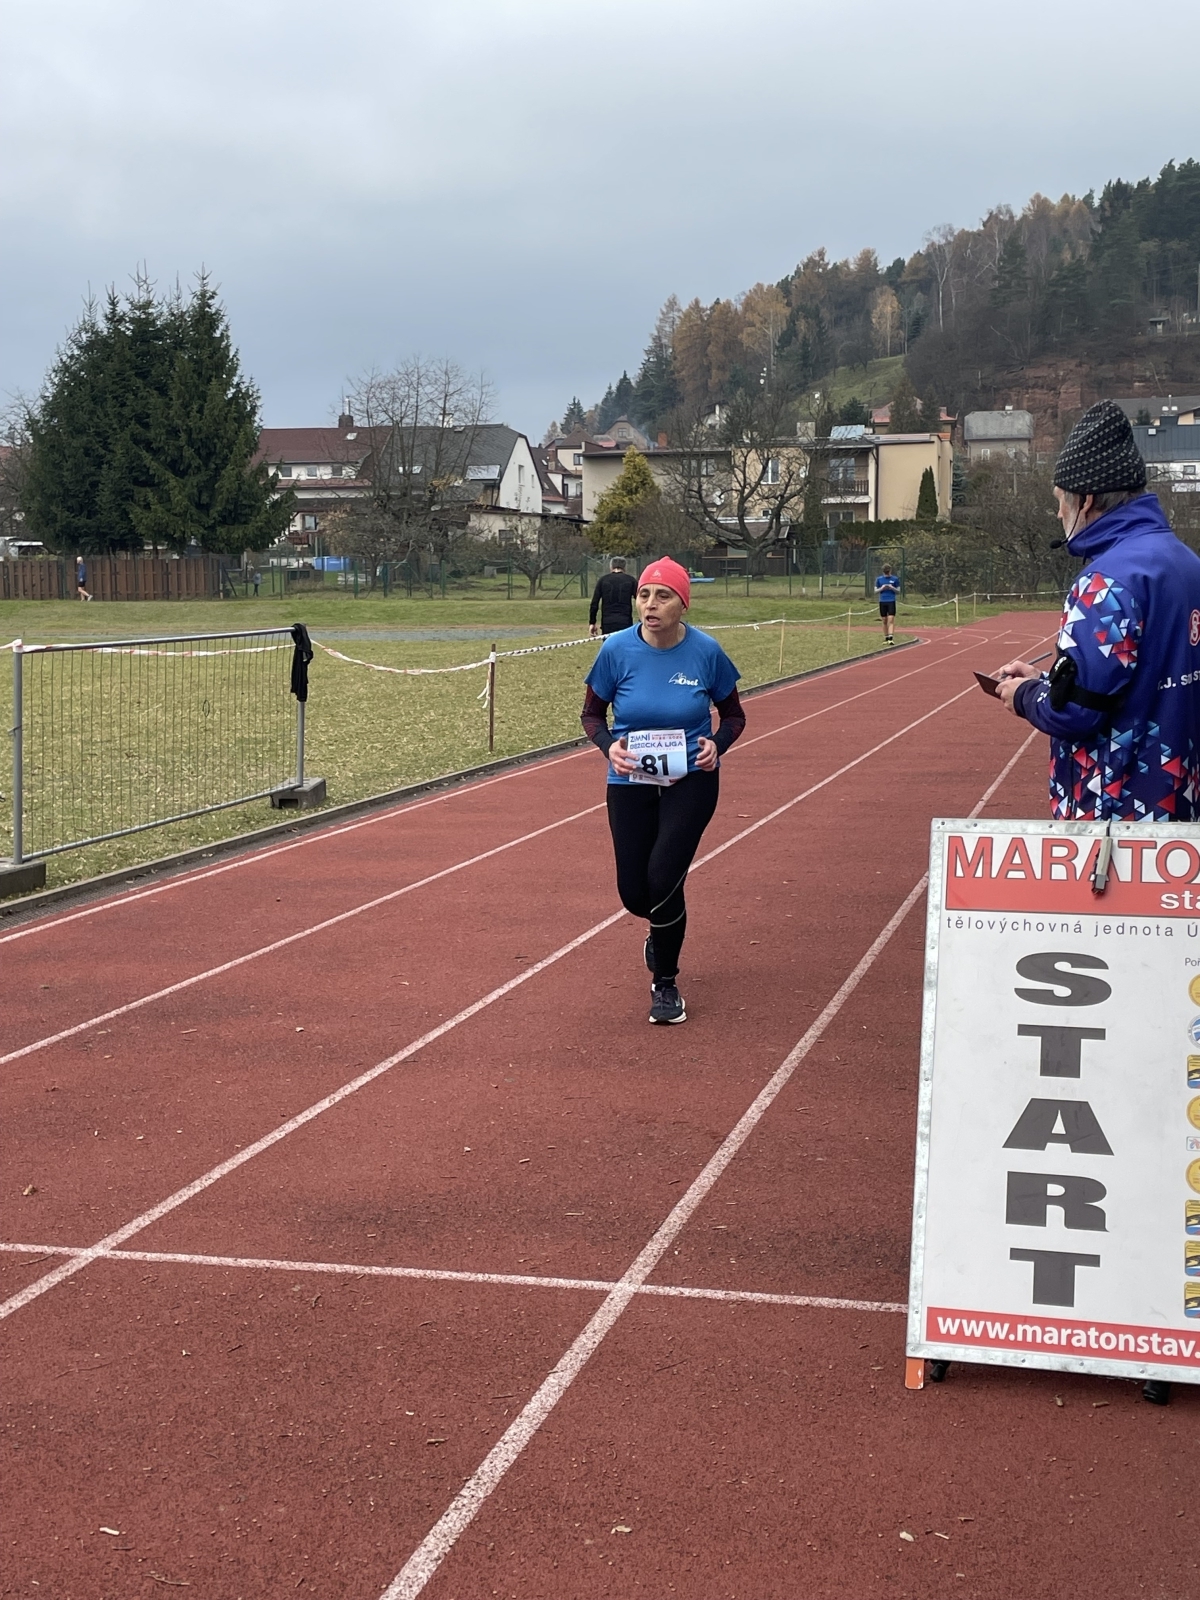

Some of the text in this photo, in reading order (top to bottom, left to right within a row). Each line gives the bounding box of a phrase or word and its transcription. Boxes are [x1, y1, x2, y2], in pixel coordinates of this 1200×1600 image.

[641, 754, 669, 776] 81
[947, 835, 1200, 885] MARATO
[946, 916, 1083, 934] tělovýchovná
[1093, 919, 1174, 938] jednota
[1002, 951, 1114, 1308] START
[937, 1315, 1200, 1359] www.maratonstav.
